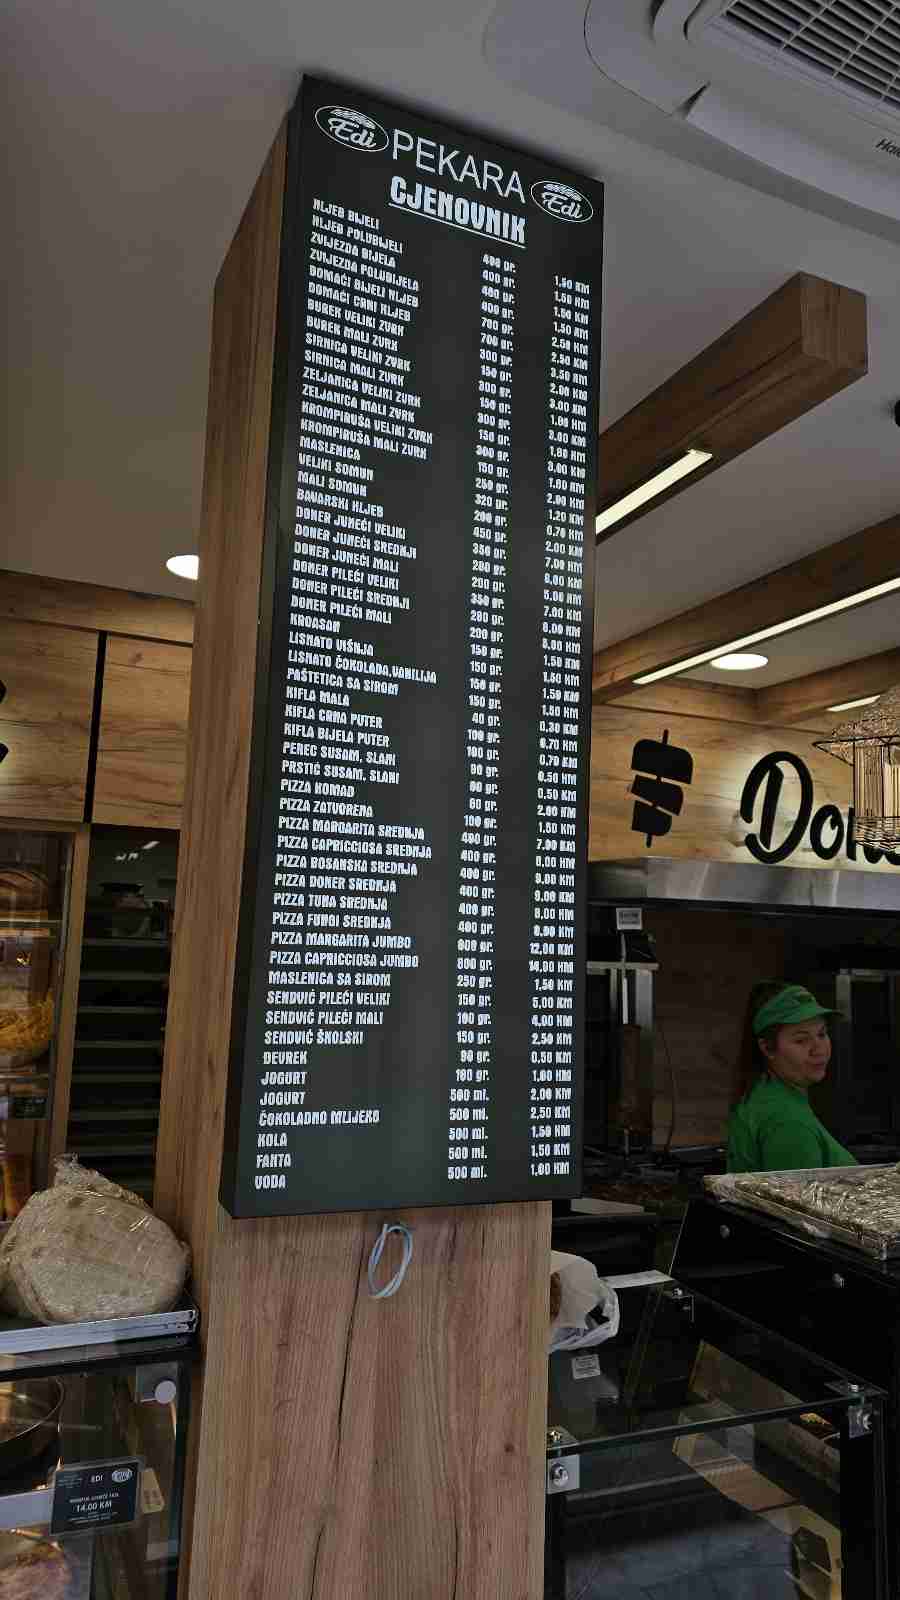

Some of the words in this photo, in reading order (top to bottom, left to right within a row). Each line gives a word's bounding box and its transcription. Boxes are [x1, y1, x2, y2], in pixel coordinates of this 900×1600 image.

[392, 128, 527, 204] PEKARA
[389, 175, 526, 244] CJENOVNIK
[347, 210, 379, 230] BIJELI
[310, 231, 358, 256] ZVIJEZDA
[361, 247, 395, 267] BIJELA
[347, 226, 402, 254] POLUBIJELI
[310, 248, 357, 273] ZVIJEZDA
[360, 263, 418, 291] POLUBIJELA
[309, 264, 351, 288] DOMAĆI
[353, 278, 385, 298] BIJELI
[308, 281, 350, 304] DOMAĆI
[353, 295, 377, 312] CRNI
[307, 298, 341, 318] BUREK
[344, 309, 375, 328] VELIKI
[574, 311, 588, 325] KM
[306, 315, 340, 335] BUREK
[343, 326, 369, 344] MALI
[305, 332, 347, 354] SIRNICA
[350, 344, 382, 363] VELIKI
[304, 349, 346, 371] SIRNICA
[349, 361, 375, 379] MALI
[303, 366, 358, 391] ZELJANICA
[361, 381, 392, 400] VELIKI
[302, 383, 357, 408] ZELJANICA
[360, 398, 386, 415] MALI
[374, 419, 405, 437] VELIKI
[299, 435, 360, 460] MASLENICA
[373, 435, 398, 452] MALI
[298, 452, 331, 472] VELIKI
[334, 461, 373, 481] SOMUN
[297, 470, 325, 487] MALI
[328, 477, 366, 496] SOMUN
[296, 488, 348, 510] BAVARSKI
[374, 521, 405, 539] VELIKI
[372, 556, 398, 572] MALI
[367, 573, 399, 590] VELIKI
[365, 608, 391, 623] MALI
[289, 631, 332, 649] LISNATO
[336, 638, 373, 656] VIŠNJA
[288, 649, 331, 667] LISNATO
[286, 667, 343, 687] PAŠTETICA
[346, 676, 360, 690] SA
[363, 679, 398, 695] SIROM
[286, 686, 316, 701] KIFLA
[319, 690, 349, 706] MALA
[285, 704, 315, 720] KIFLA
[318, 708, 347, 724] CRNA
[350, 712, 382, 728] PUTER
[284, 722, 314, 738] KIFLA
[317, 726, 353, 743] BIJELA
[357, 731, 389, 747] PUTER
[366, 751, 395, 765] SLANI
[369, 769, 399, 784] SLANI
[280, 778, 311, 794] PIZZA
[314, 781, 354, 797] KOMAD
[279, 797, 310, 812] PIZZA
[278, 815, 309, 831] PIZZA
[378, 824, 424, 840] SREDNJA
[277, 835, 308, 849] PIZZA
[385, 843, 432, 858] SREDNJA
[276, 853, 307, 868] PIZZA
[370, 860, 417, 876] SREDNJA
[274, 872, 305, 887] PIZZA
[348, 877, 396, 893] SREDNJA
[273, 892, 304, 907] PIZZA
[308, 893, 336, 908] TUNA
[339, 895, 387, 910] SREDNJA
[272, 911, 303, 925] PIZZA
[342, 915, 391, 930] SREDNJA
[270, 931, 302, 944] PIZZA
[371, 935, 411, 949] JUMBO
[269, 950, 301, 964] PIZZA
[379, 954, 419, 968] JUMBO
[268, 970, 333, 985] MASLENICA
[336, 972, 351, 986] SA
[354, 972, 391, 987] SIROM
[356, 992, 390, 1006] VELIKI
[355, 1011, 383, 1024] MALI
[260, 1071, 307, 1084] JOGURT
[260, 1091, 305, 1105] JOGURT
[330, 1110, 379, 1124] MLIJEKO
[554, 1105, 570, 1118] KM
[257, 1133, 287, 1147] KOLA
[448, 1127, 468, 1140] 500
[553, 1142, 570, 1155] KM
[256, 1153, 291, 1168] FANTA
[254, 1174, 285, 1189] VODA
[448, 1166, 467, 1179] 500
[99, 1500, 112, 1509] KM
